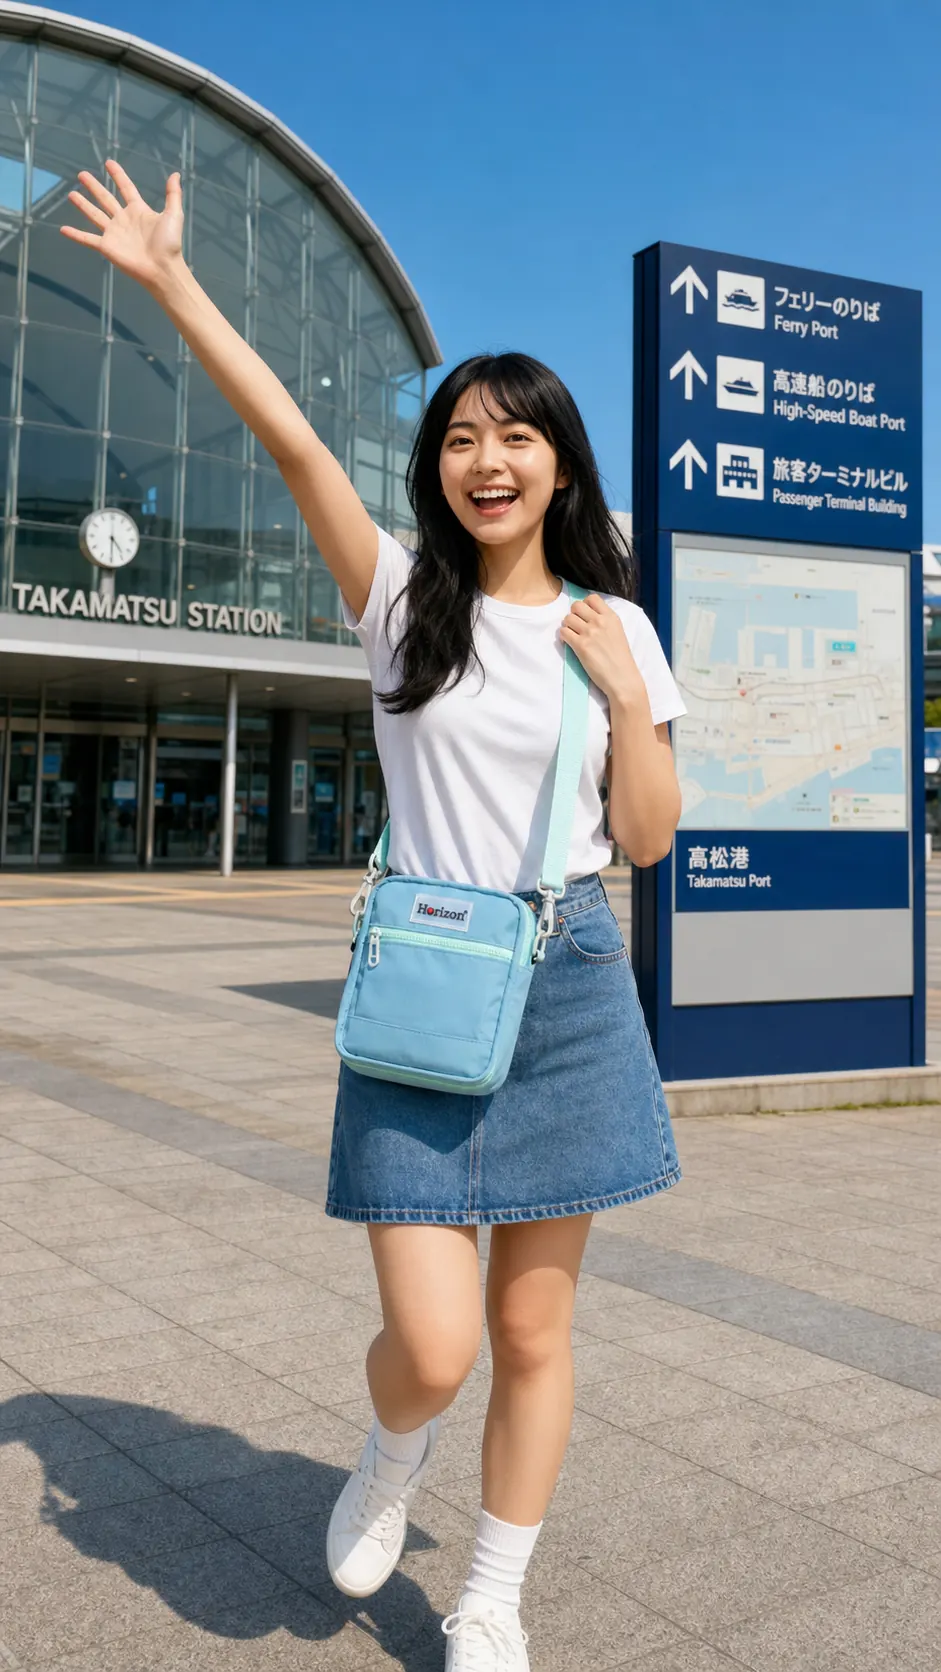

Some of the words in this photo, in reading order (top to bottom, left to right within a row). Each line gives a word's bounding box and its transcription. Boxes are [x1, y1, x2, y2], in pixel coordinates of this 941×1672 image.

[774, 286, 881, 322] フェリーのりば
[774, 315, 808, 338] Ferry
[811, 321, 839, 339] Port
[773, 369, 875, 403] 高速船のりば
[773, 400, 846, 424] High-Speed
[849, 409, 878, 428] Boat
[880, 413, 906, 431] Port
[773, 457, 908, 492] 旅客ターミナルビル
[773, 488, 824, 511] Passenger
[824, 493, 866, 511] Terminal
[868, 498, 907, 519] Building
[12, 583, 177, 625] TAKAMATSU
[188, 602, 282, 635] STATION
[688, 846, 749, 870] 高松港
[687, 874, 746, 888] Takamatsu
[748, 874, 771, 887] Port
